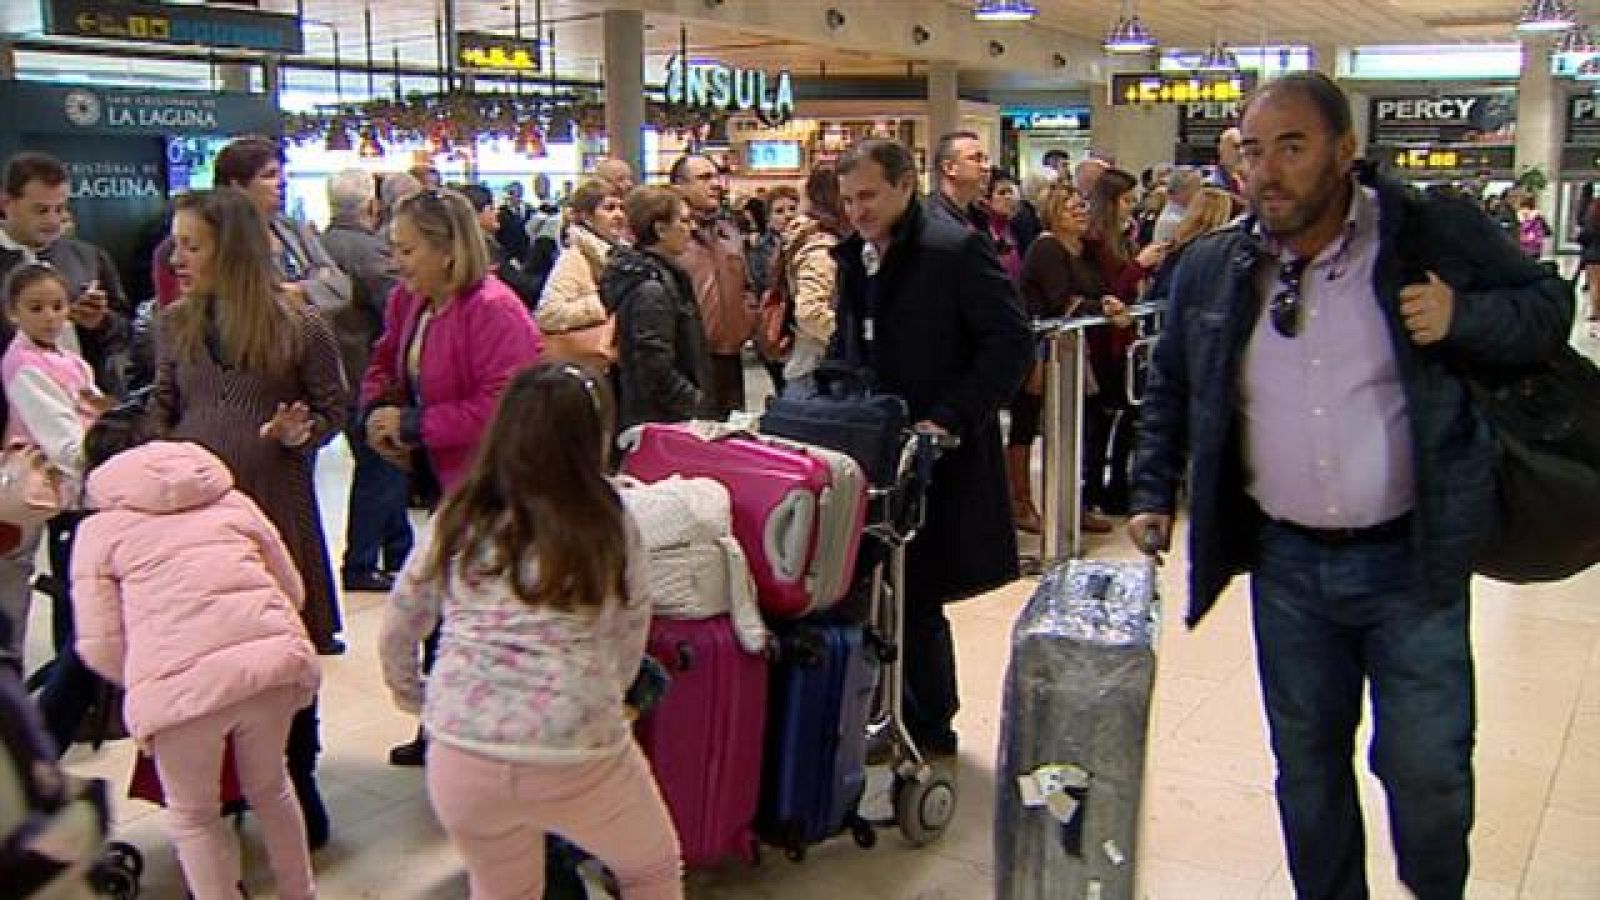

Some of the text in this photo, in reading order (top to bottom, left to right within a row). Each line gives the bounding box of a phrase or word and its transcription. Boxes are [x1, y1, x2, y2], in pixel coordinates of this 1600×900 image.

[108, 107, 218, 128] LA LAGUNA
[1187, 102, 1240, 119] PER
[1378, 97, 1475, 119] PERCY
[68, 176, 160, 197] LAGUNA
